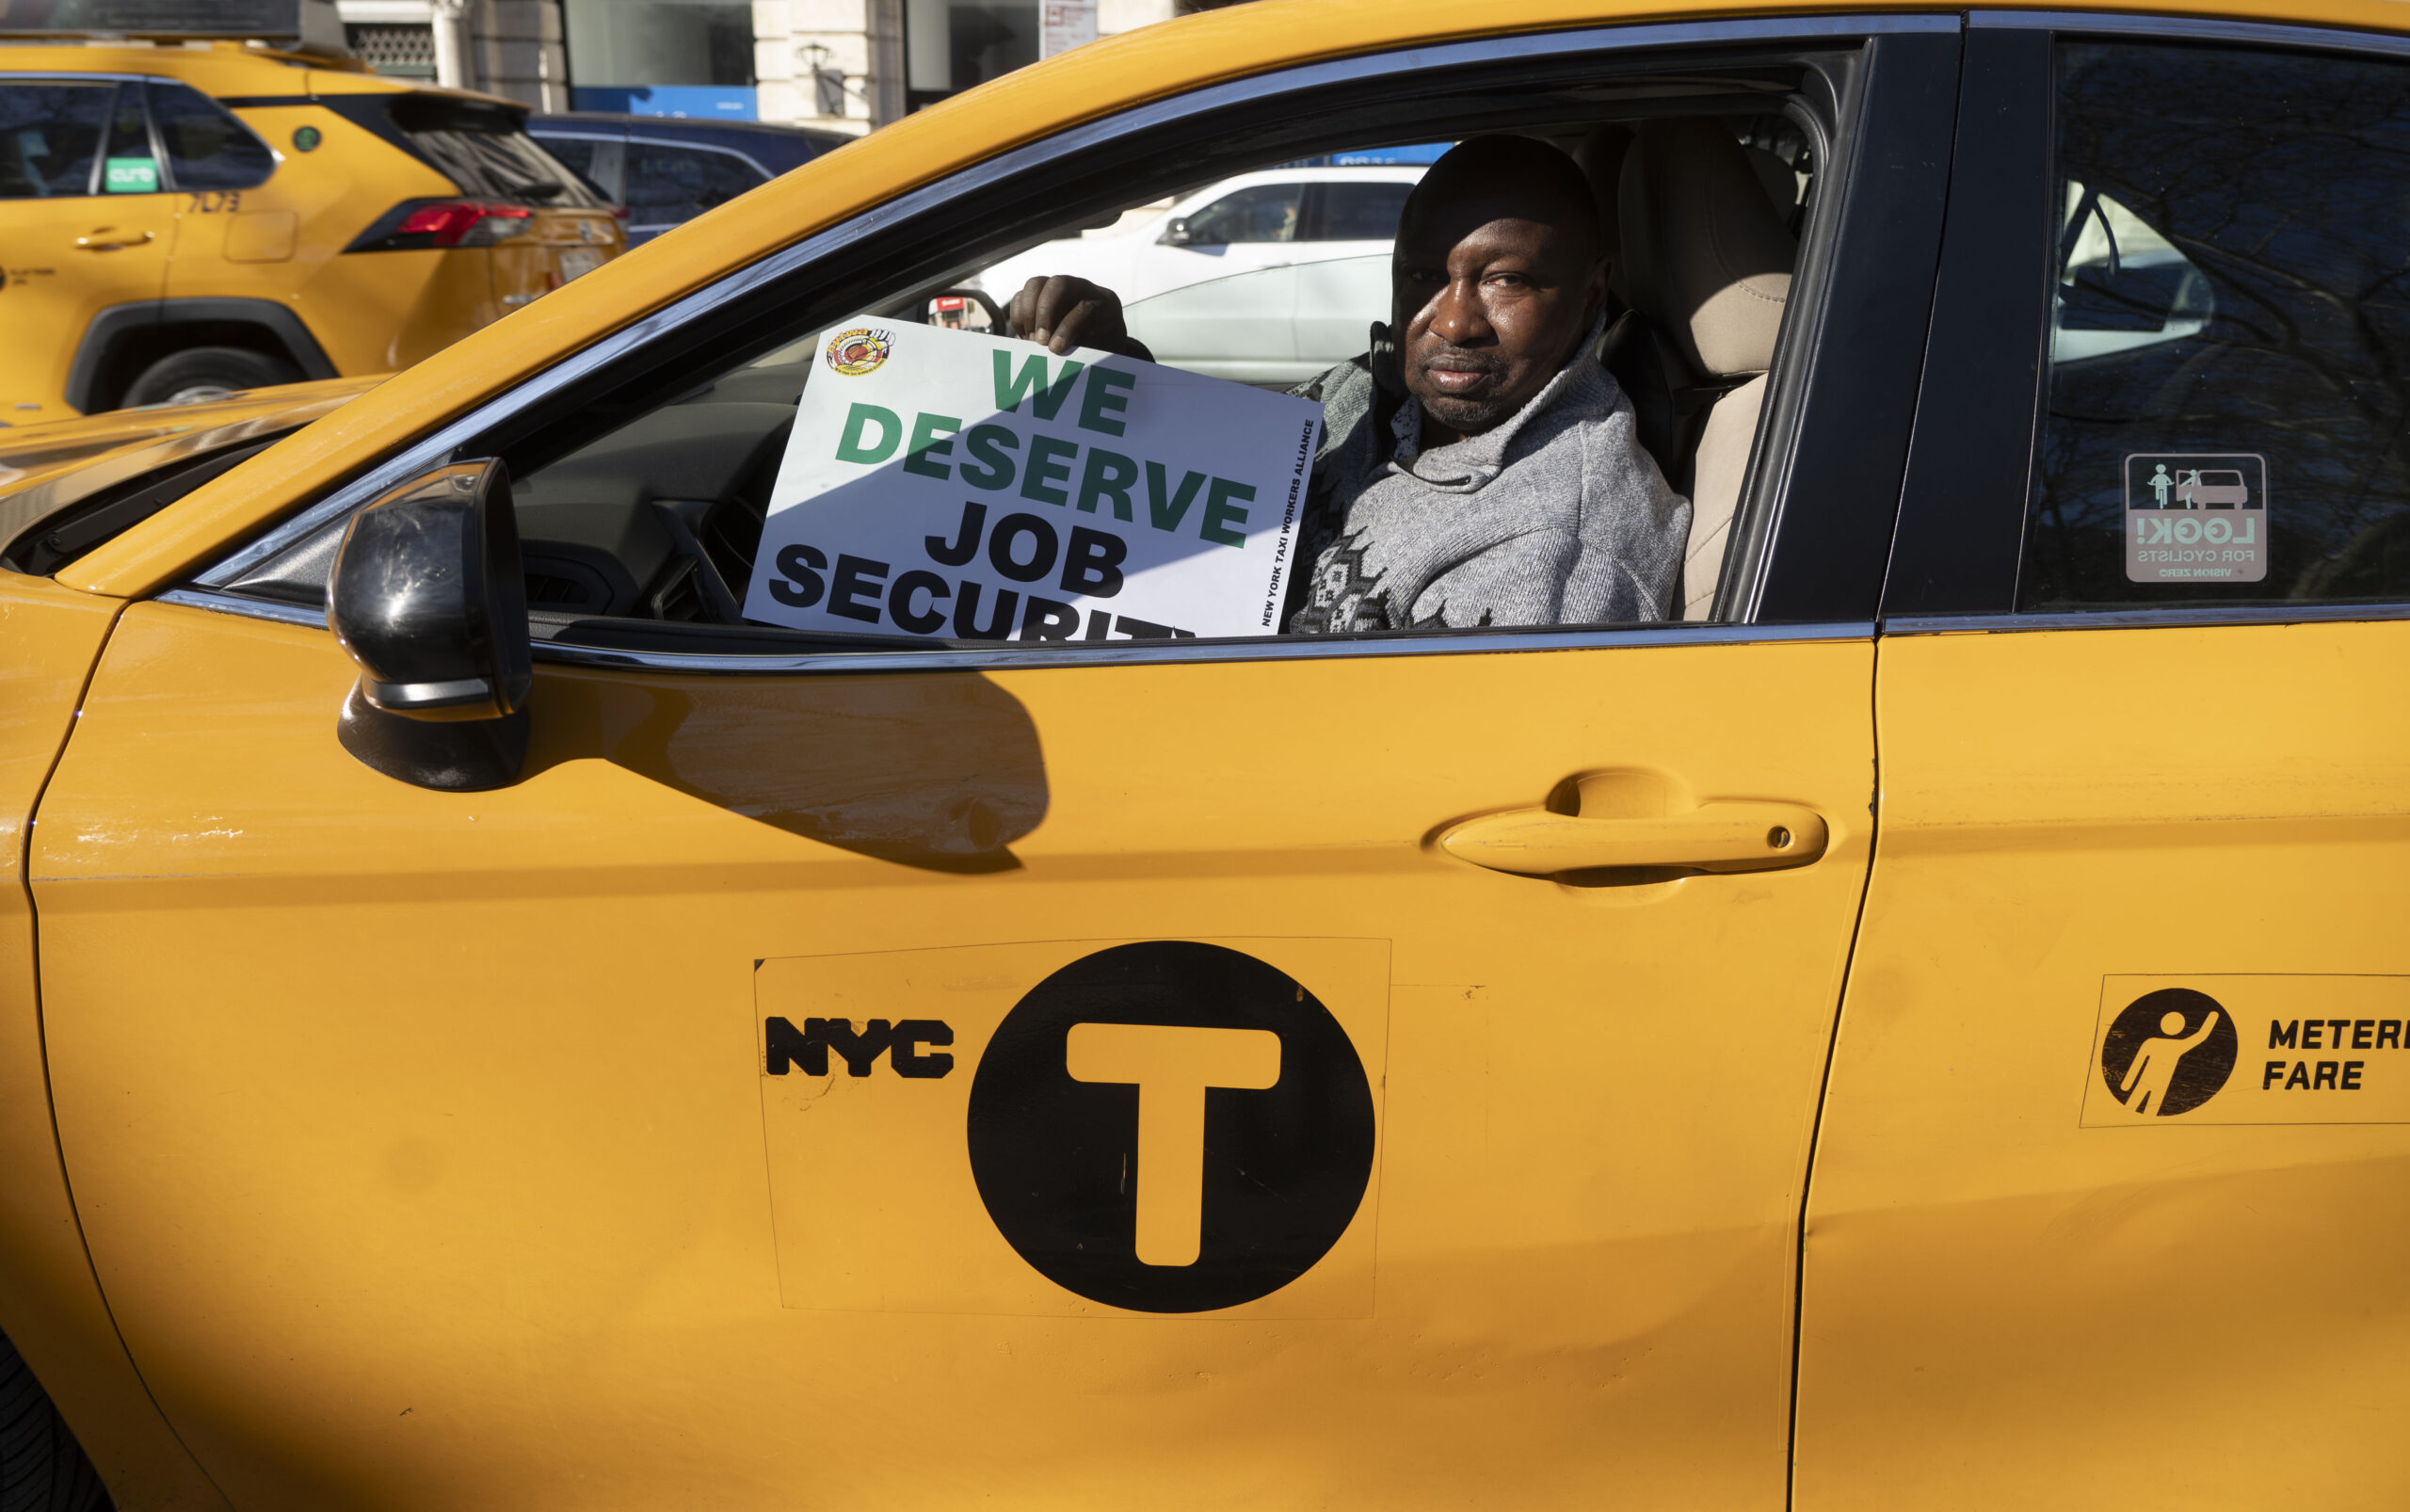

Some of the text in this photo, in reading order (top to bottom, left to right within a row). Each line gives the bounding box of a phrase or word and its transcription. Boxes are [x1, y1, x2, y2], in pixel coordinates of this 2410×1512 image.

[992, 349, 1136, 438] WE
[835, 402, 1257, 549] DESERVE
[1261, 419, 1314, 627] NEW YORK TAXI WORKERS ALLIANCE
[768, 543, 1197, 642] SECURI
[924, 501, 1128, 599] JOB
[2262, 1061, 2365, 1090] FARE
[2268, 1019, 2410, 1050] METER
[765, 1016, 1282, 1267] NYC T
